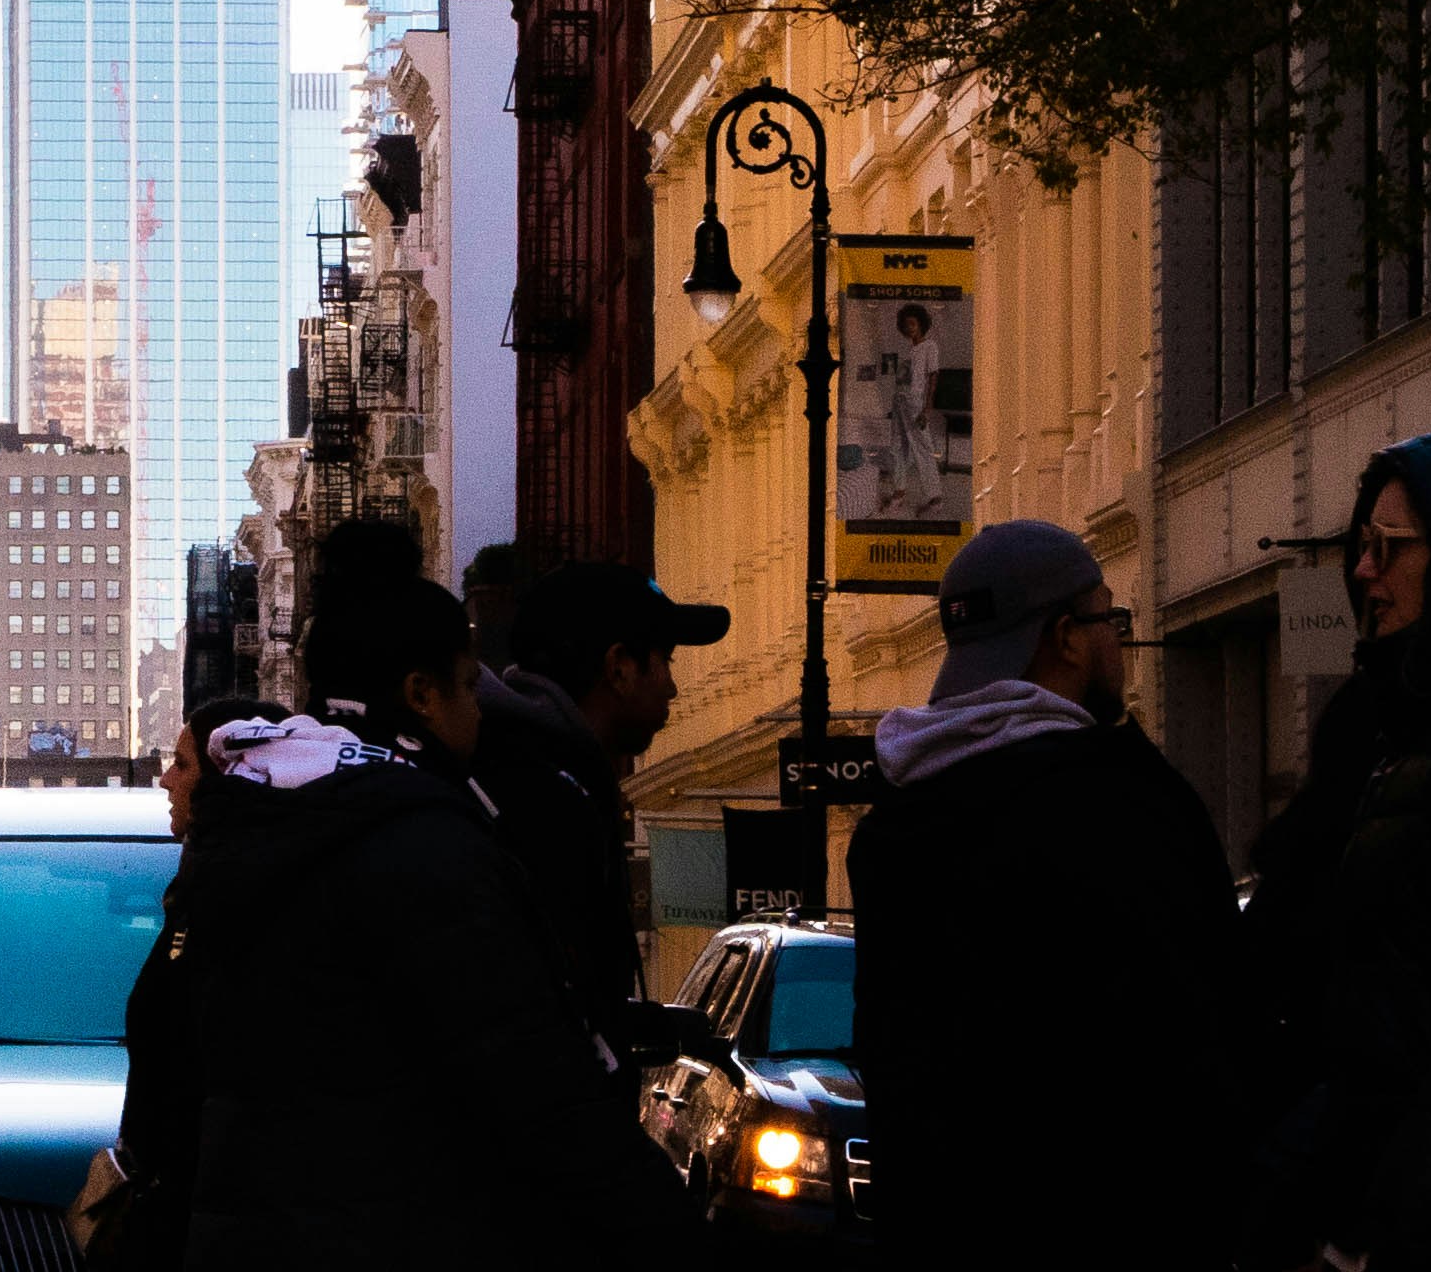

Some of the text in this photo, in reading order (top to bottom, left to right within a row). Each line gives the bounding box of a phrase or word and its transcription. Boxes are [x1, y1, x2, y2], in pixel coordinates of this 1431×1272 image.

[883, 254, 928, 269] NYC
[868, 287, 943, 297] SHOP SOHO
[869, 539, 937, 564] melissa
[1289, 614, 1348, 631] LINDA
